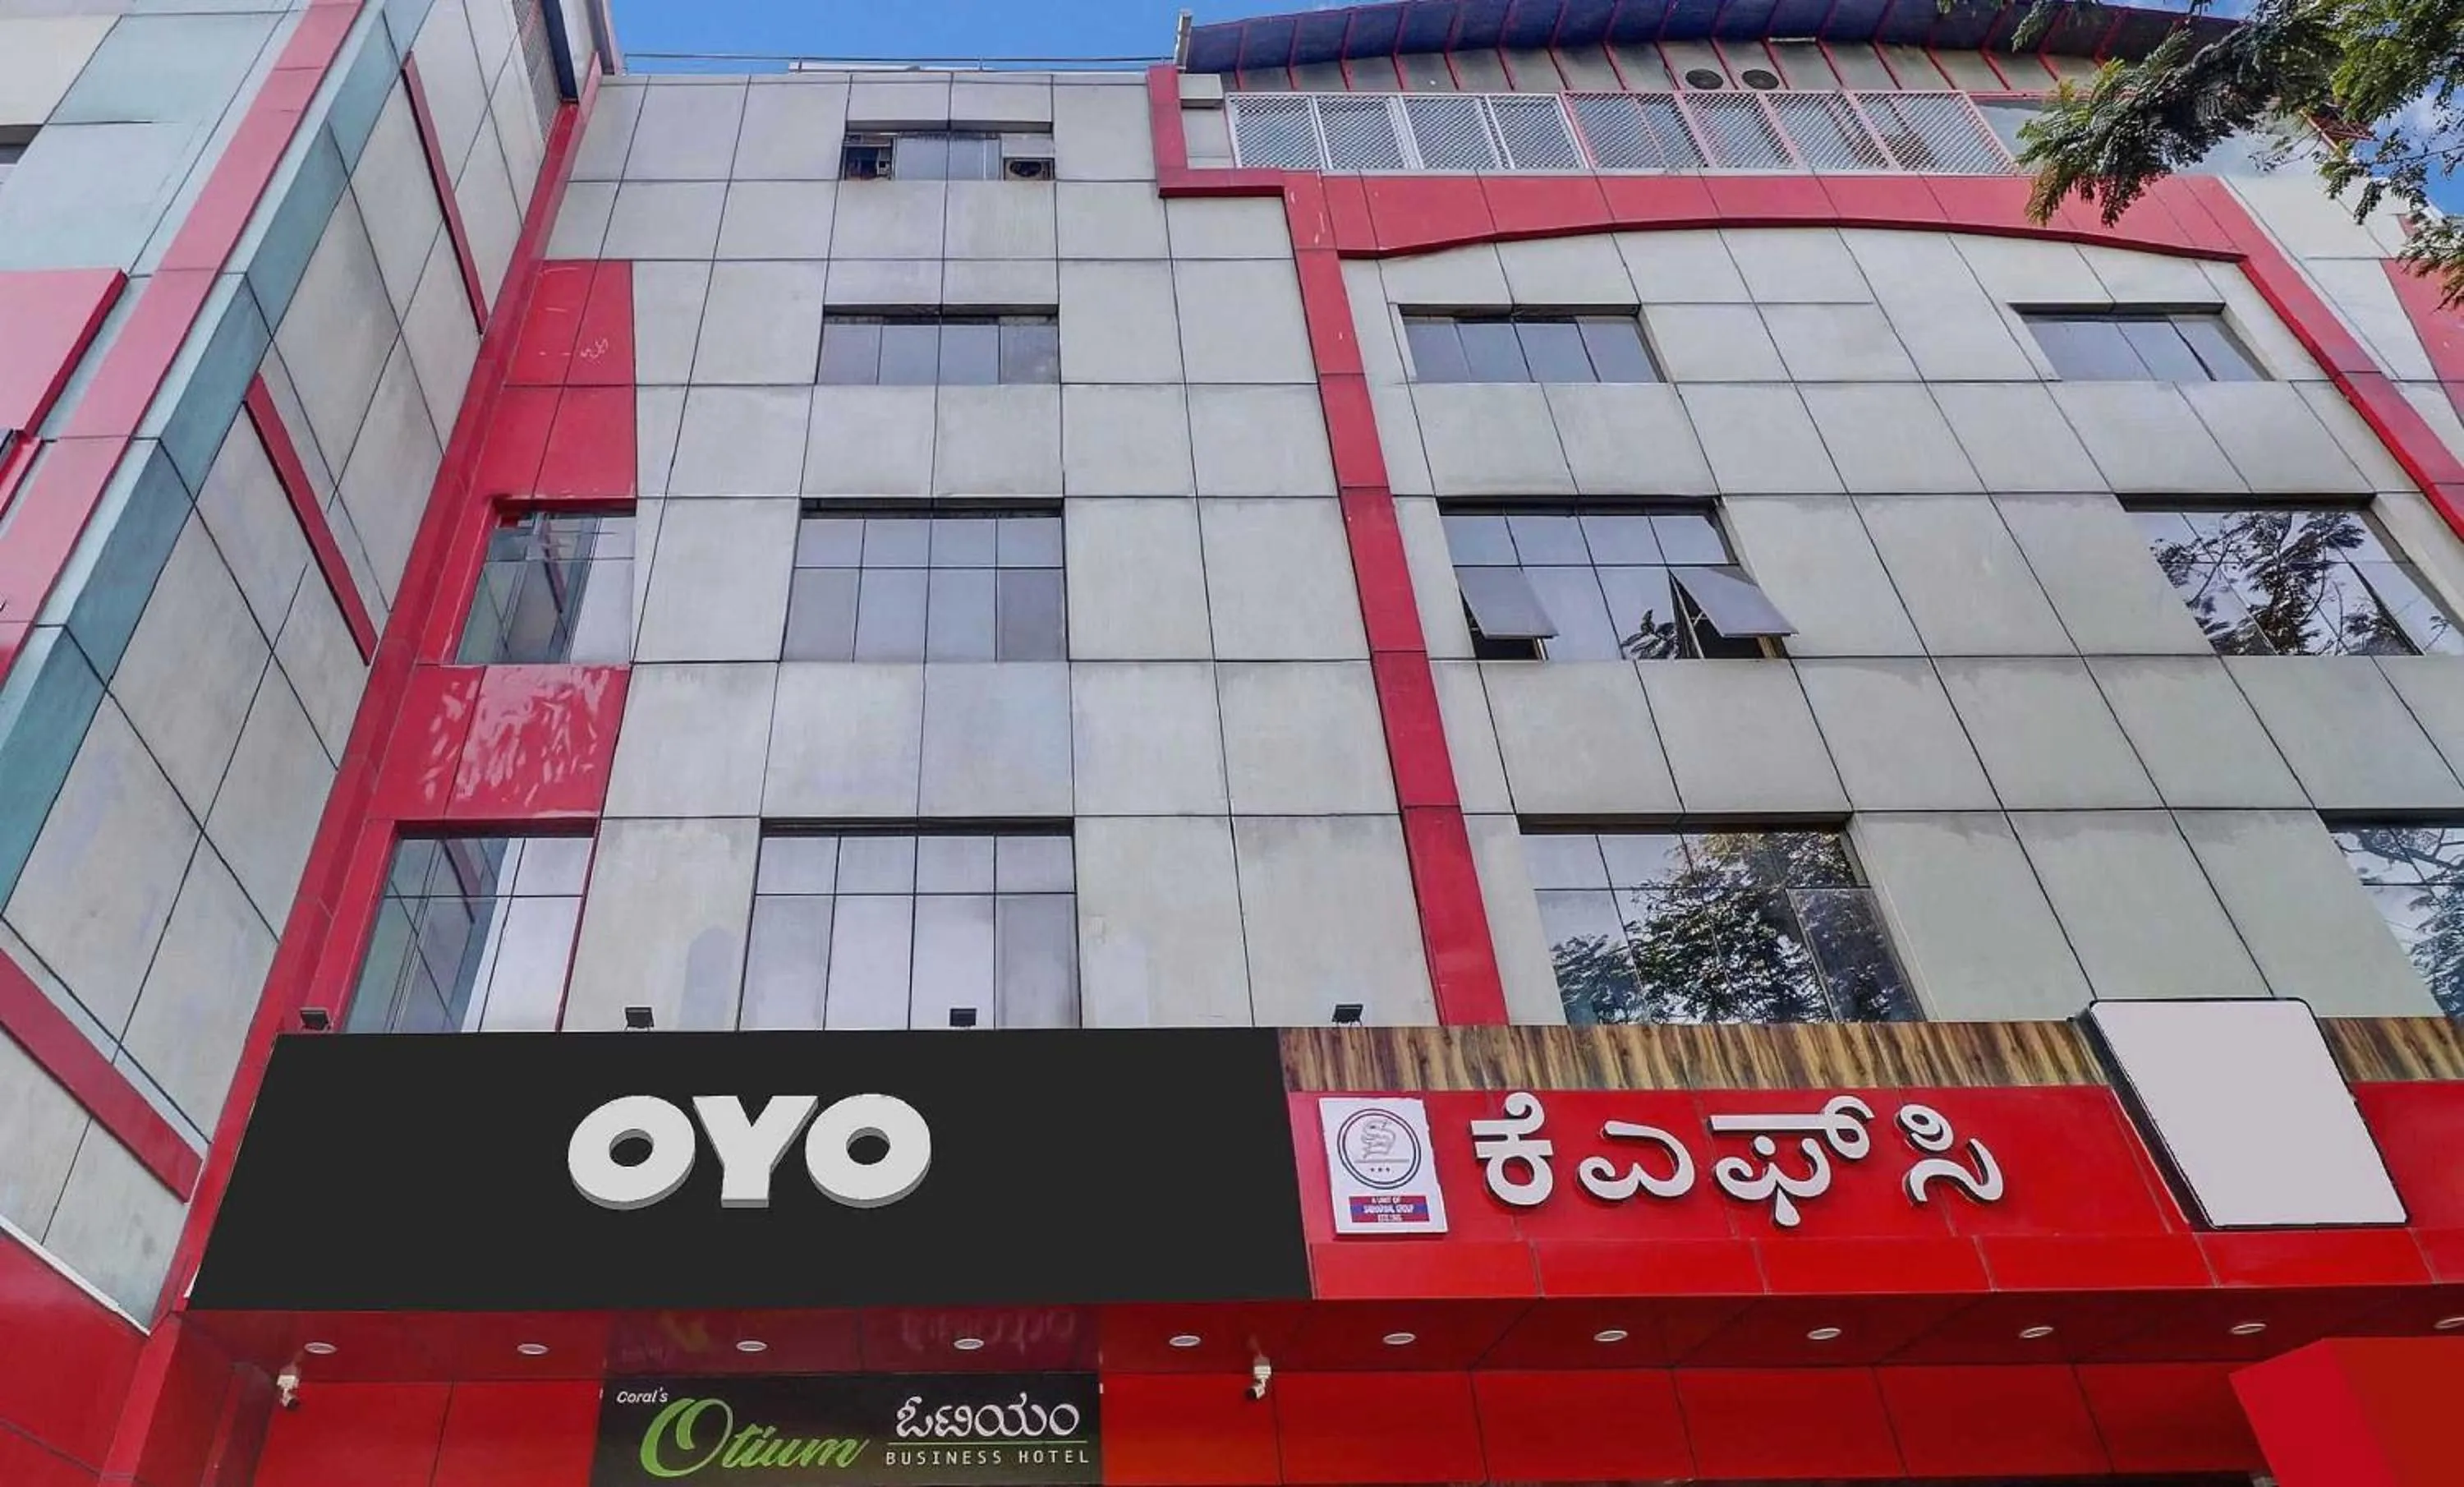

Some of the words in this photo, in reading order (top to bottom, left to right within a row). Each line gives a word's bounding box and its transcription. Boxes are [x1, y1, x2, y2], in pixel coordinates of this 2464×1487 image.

[567, 1093, 932, 1210] OYO
[616, 1387, 669, 1404] Coral's
[895, 1391, 1081, 1438] ಓಟಿಯಂ
[640, 1397, 871, 1478] Otium
[885, 1450, 1003, 1466] BUSINESS
[1018, 1449, 1090, 1465] HOTEL
